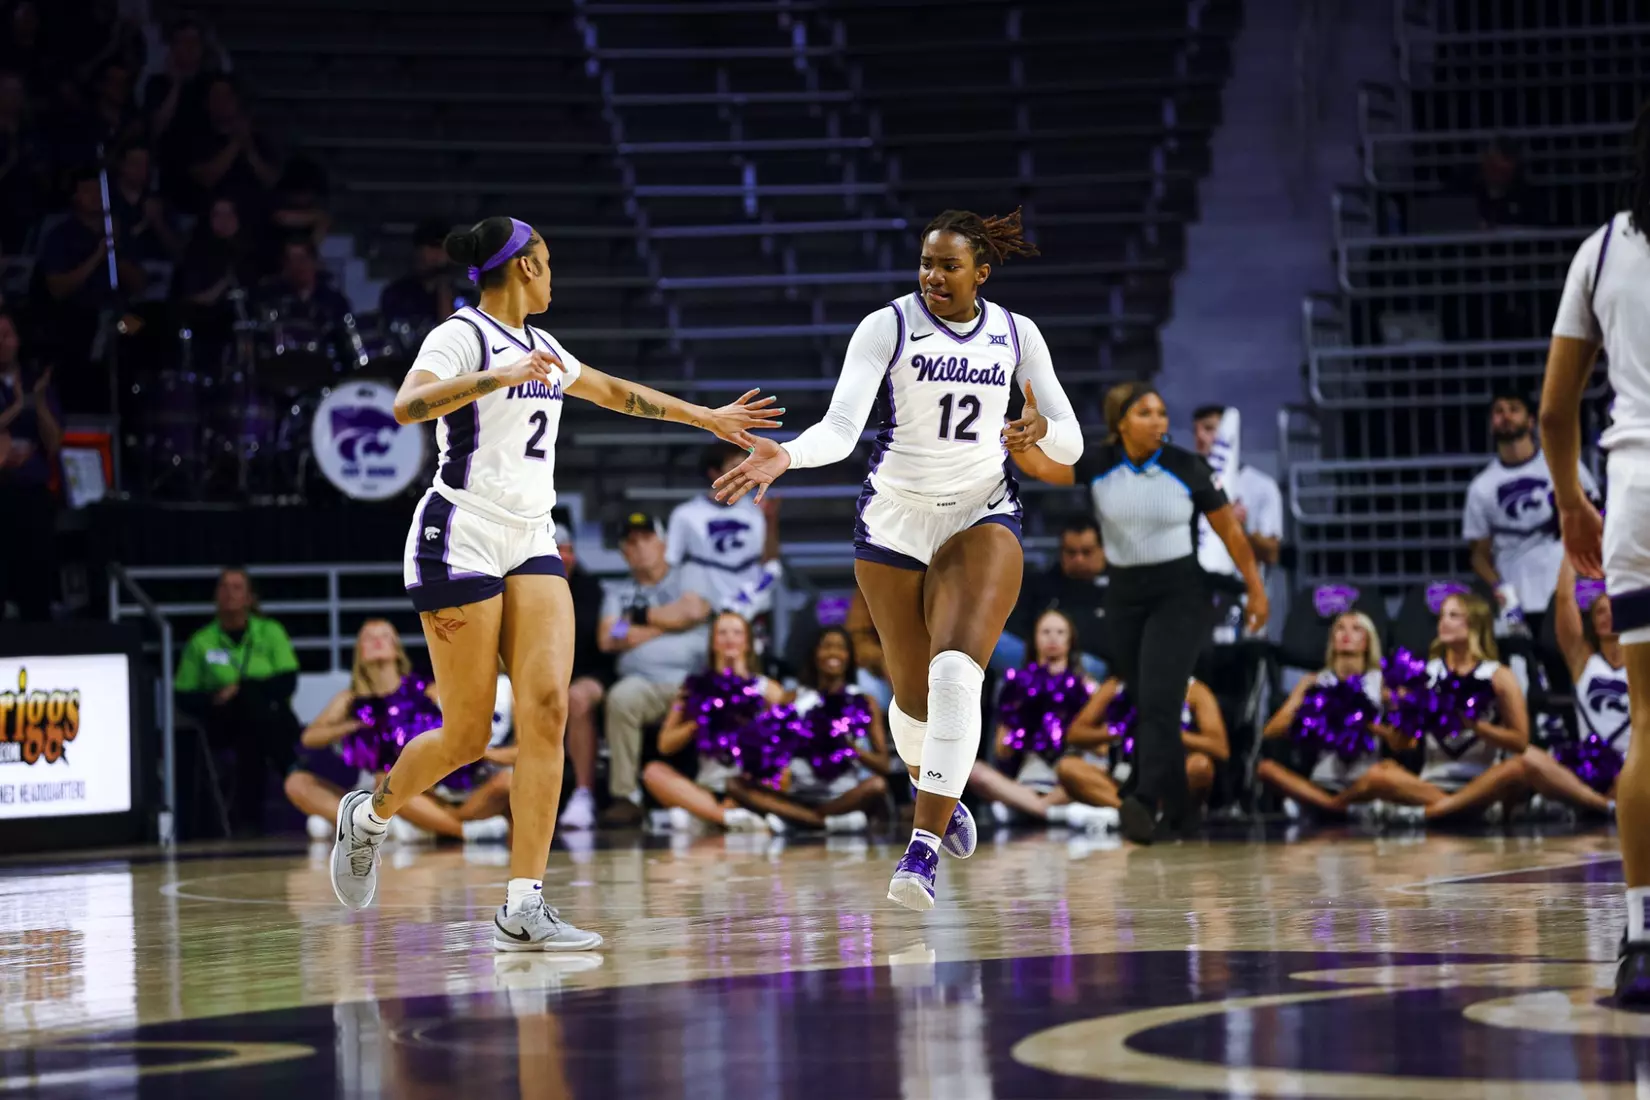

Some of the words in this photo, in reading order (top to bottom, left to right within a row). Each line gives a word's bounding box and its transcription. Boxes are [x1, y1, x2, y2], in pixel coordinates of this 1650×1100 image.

[911, 354, 1006, 387] Wildcats
[523, 409, 549, 462] 2
[938, 392, 982, 443] 12
